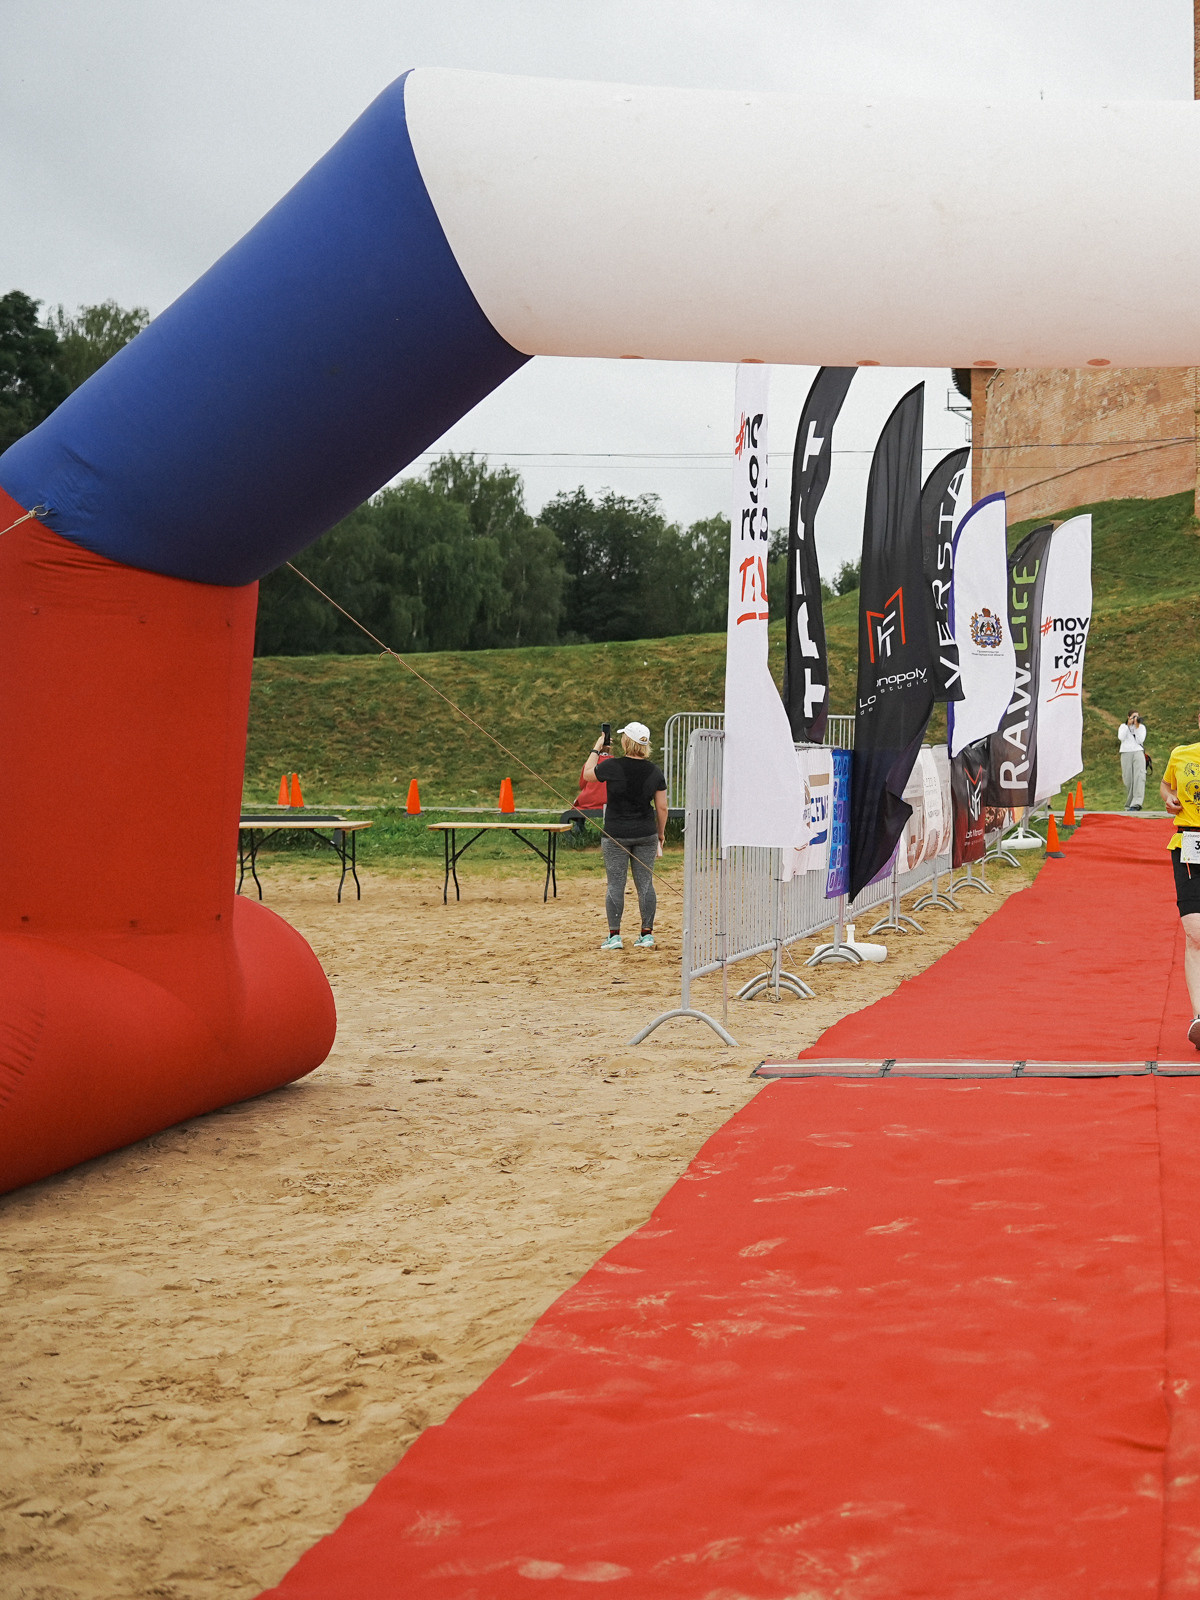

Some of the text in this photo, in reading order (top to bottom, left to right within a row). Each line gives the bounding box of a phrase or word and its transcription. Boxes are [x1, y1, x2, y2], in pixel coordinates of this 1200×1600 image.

[932, 467, 965, 689] VERSTA
[1041, 616, 1089, 637] #nov
[1064, 633, 1085, 655] go
[880, 678, 927, 694] studio
